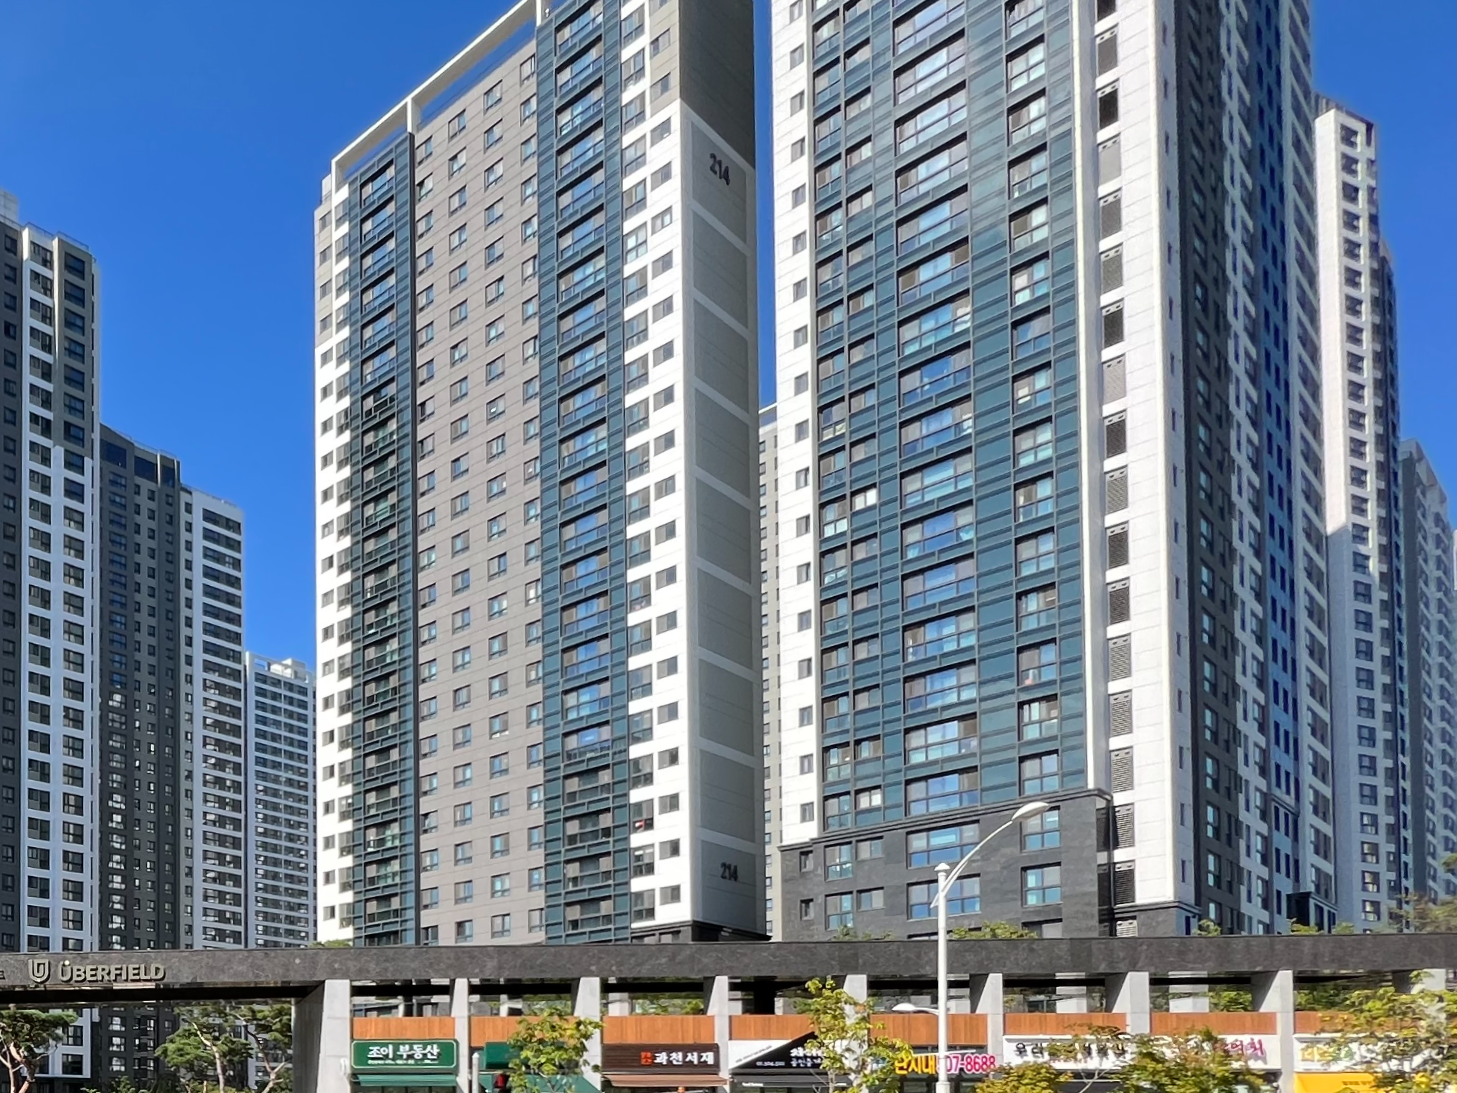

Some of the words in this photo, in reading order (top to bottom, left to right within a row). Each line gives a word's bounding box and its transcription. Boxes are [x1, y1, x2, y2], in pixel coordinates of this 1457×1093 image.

[709, 152, 731, 186] 214
[720, 861, 739, 882] 214
[367, 1044, 394, 1058] 조이
[396, 1044, 441, 1060] 부동산
[653, 1051, 715, 1066] 과천서재
[936, 1054, 996, 1074] 07-8688
